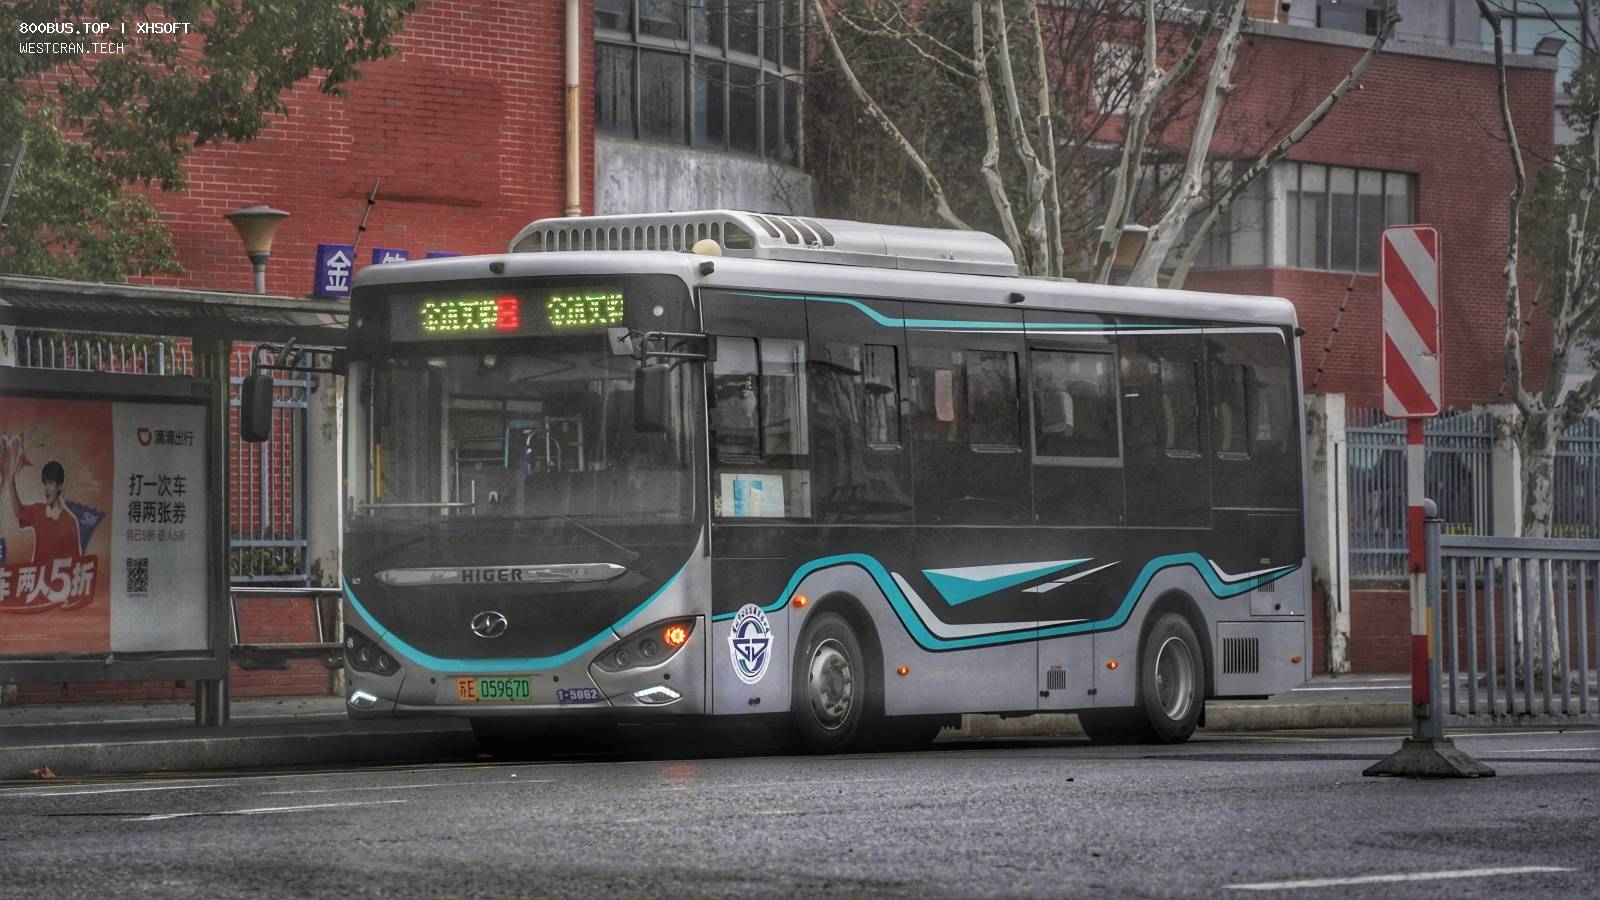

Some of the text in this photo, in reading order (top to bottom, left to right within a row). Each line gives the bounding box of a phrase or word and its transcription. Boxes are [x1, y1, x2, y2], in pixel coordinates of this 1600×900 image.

[154, 430, 194, 446] 滴滴出行
[129, 474, 187, 497] 打一次车
[128, 501, 187, 524] 得两张券
[462, 567, 523, 583] HIGER
[481, 680, 530, 698] 05967D
